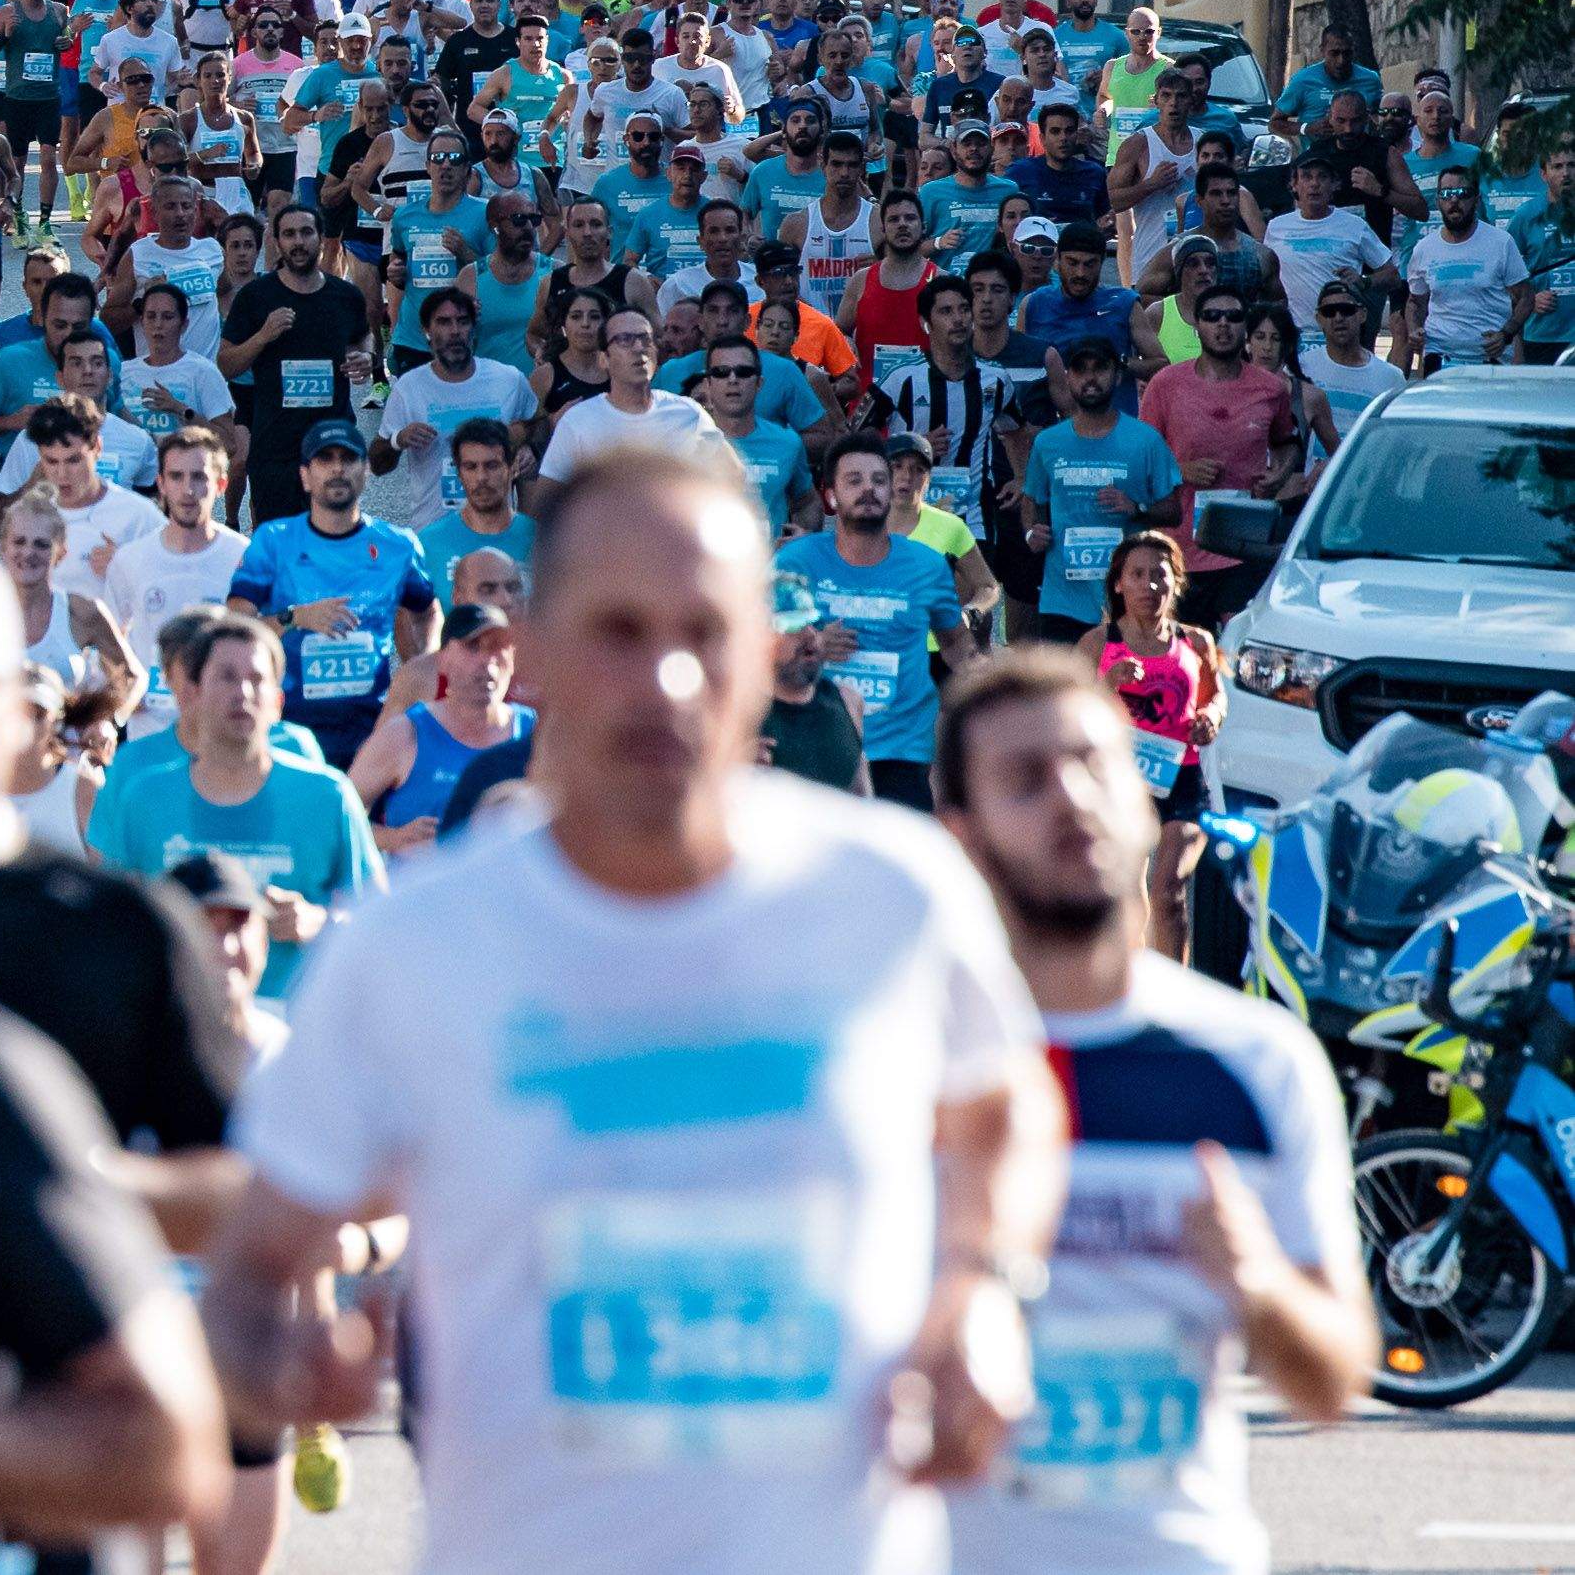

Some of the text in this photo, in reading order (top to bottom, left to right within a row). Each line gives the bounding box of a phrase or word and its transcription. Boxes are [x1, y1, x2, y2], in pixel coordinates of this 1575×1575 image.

[419, 263, 449, 277] 160
[286, 379, 330, 394] 2721
[307, 658, 372, 678] 4215
